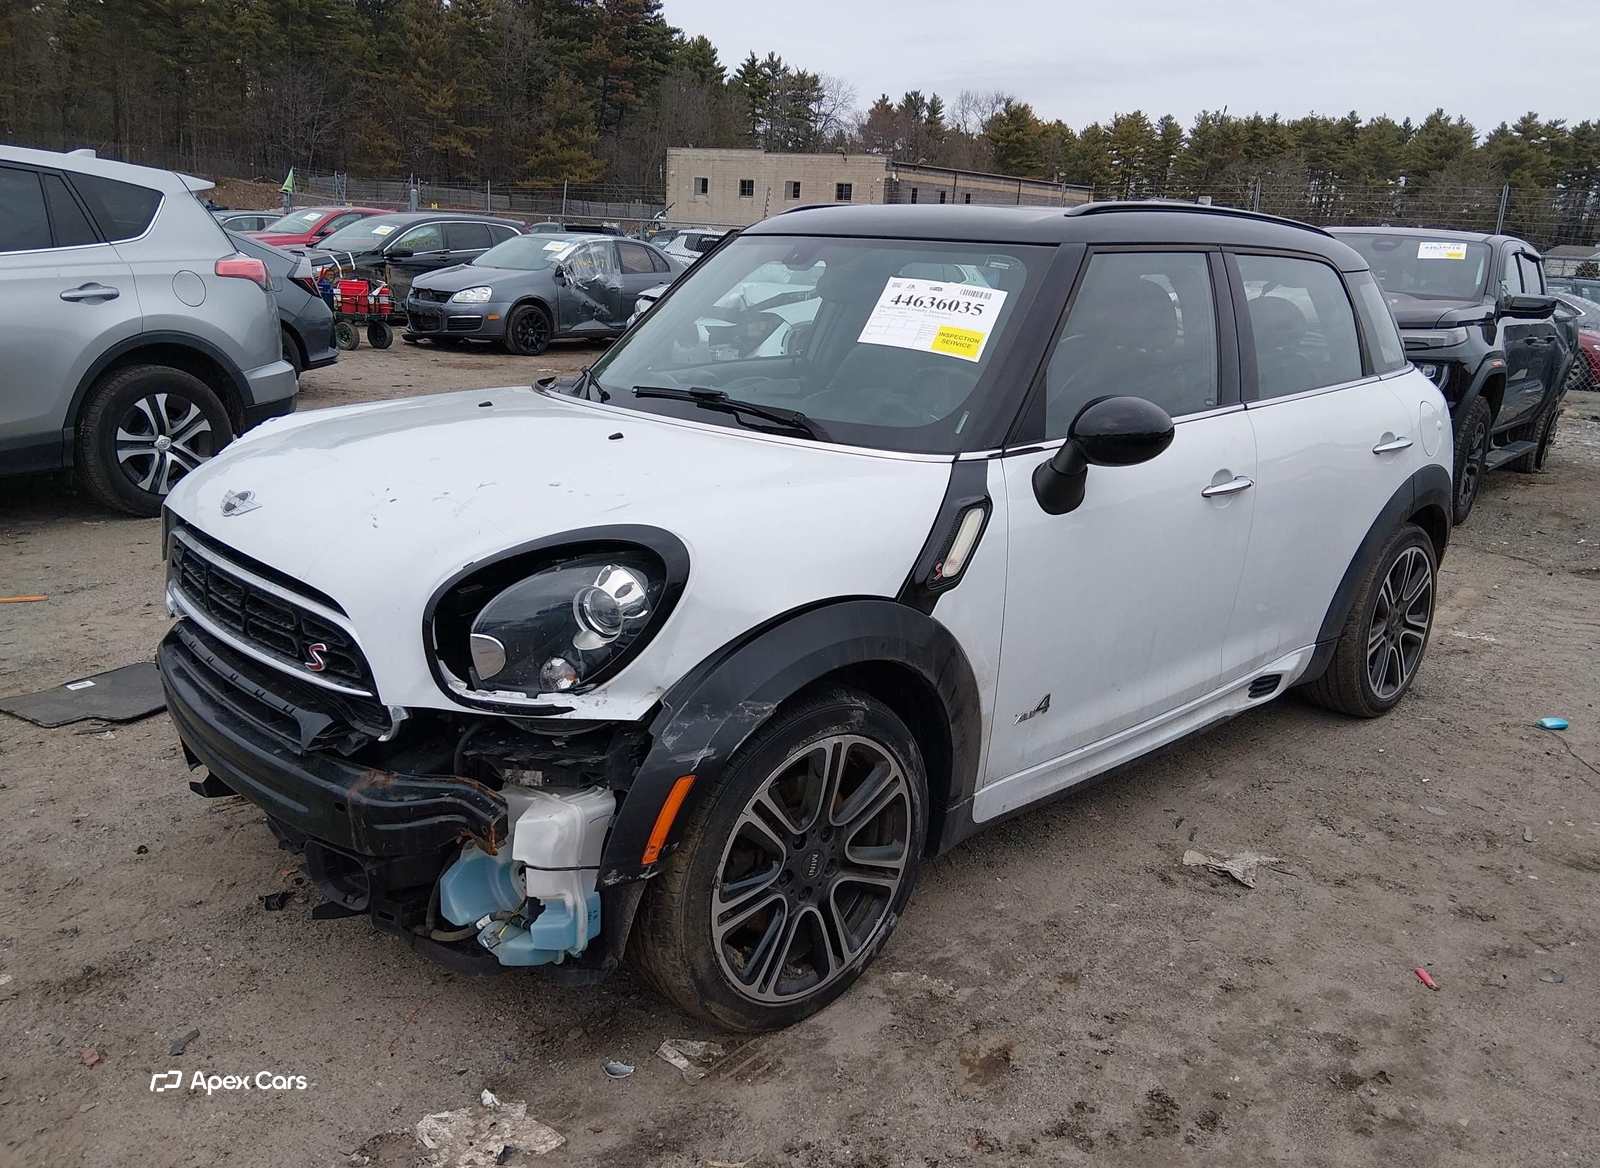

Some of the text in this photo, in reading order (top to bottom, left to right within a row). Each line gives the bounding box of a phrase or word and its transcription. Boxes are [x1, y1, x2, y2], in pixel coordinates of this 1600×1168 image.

[890, 294, 985, 316] 44636035
[938, 331, 980, 344] INSPECTION
[941, 338, 972, 350] SERVICE
[304, 643, 327, 671] S
[808, 854, 819, 876] MINI
